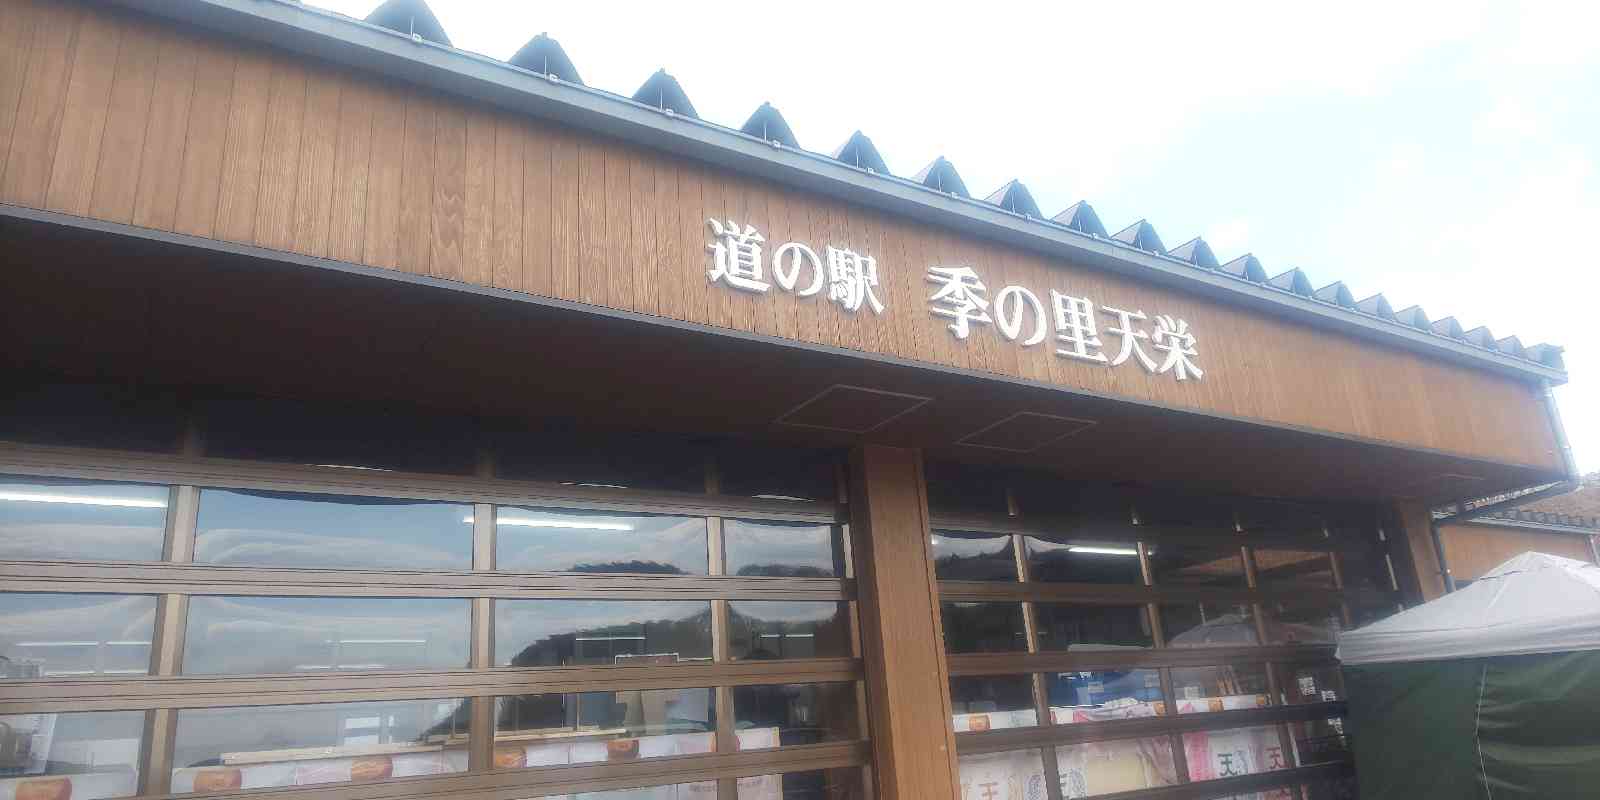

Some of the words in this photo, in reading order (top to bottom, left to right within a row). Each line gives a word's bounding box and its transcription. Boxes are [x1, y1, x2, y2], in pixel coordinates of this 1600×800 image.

[706, 217, 885, 315] 道の駅
[927, 266, 1204, 381] 季の里天栄
